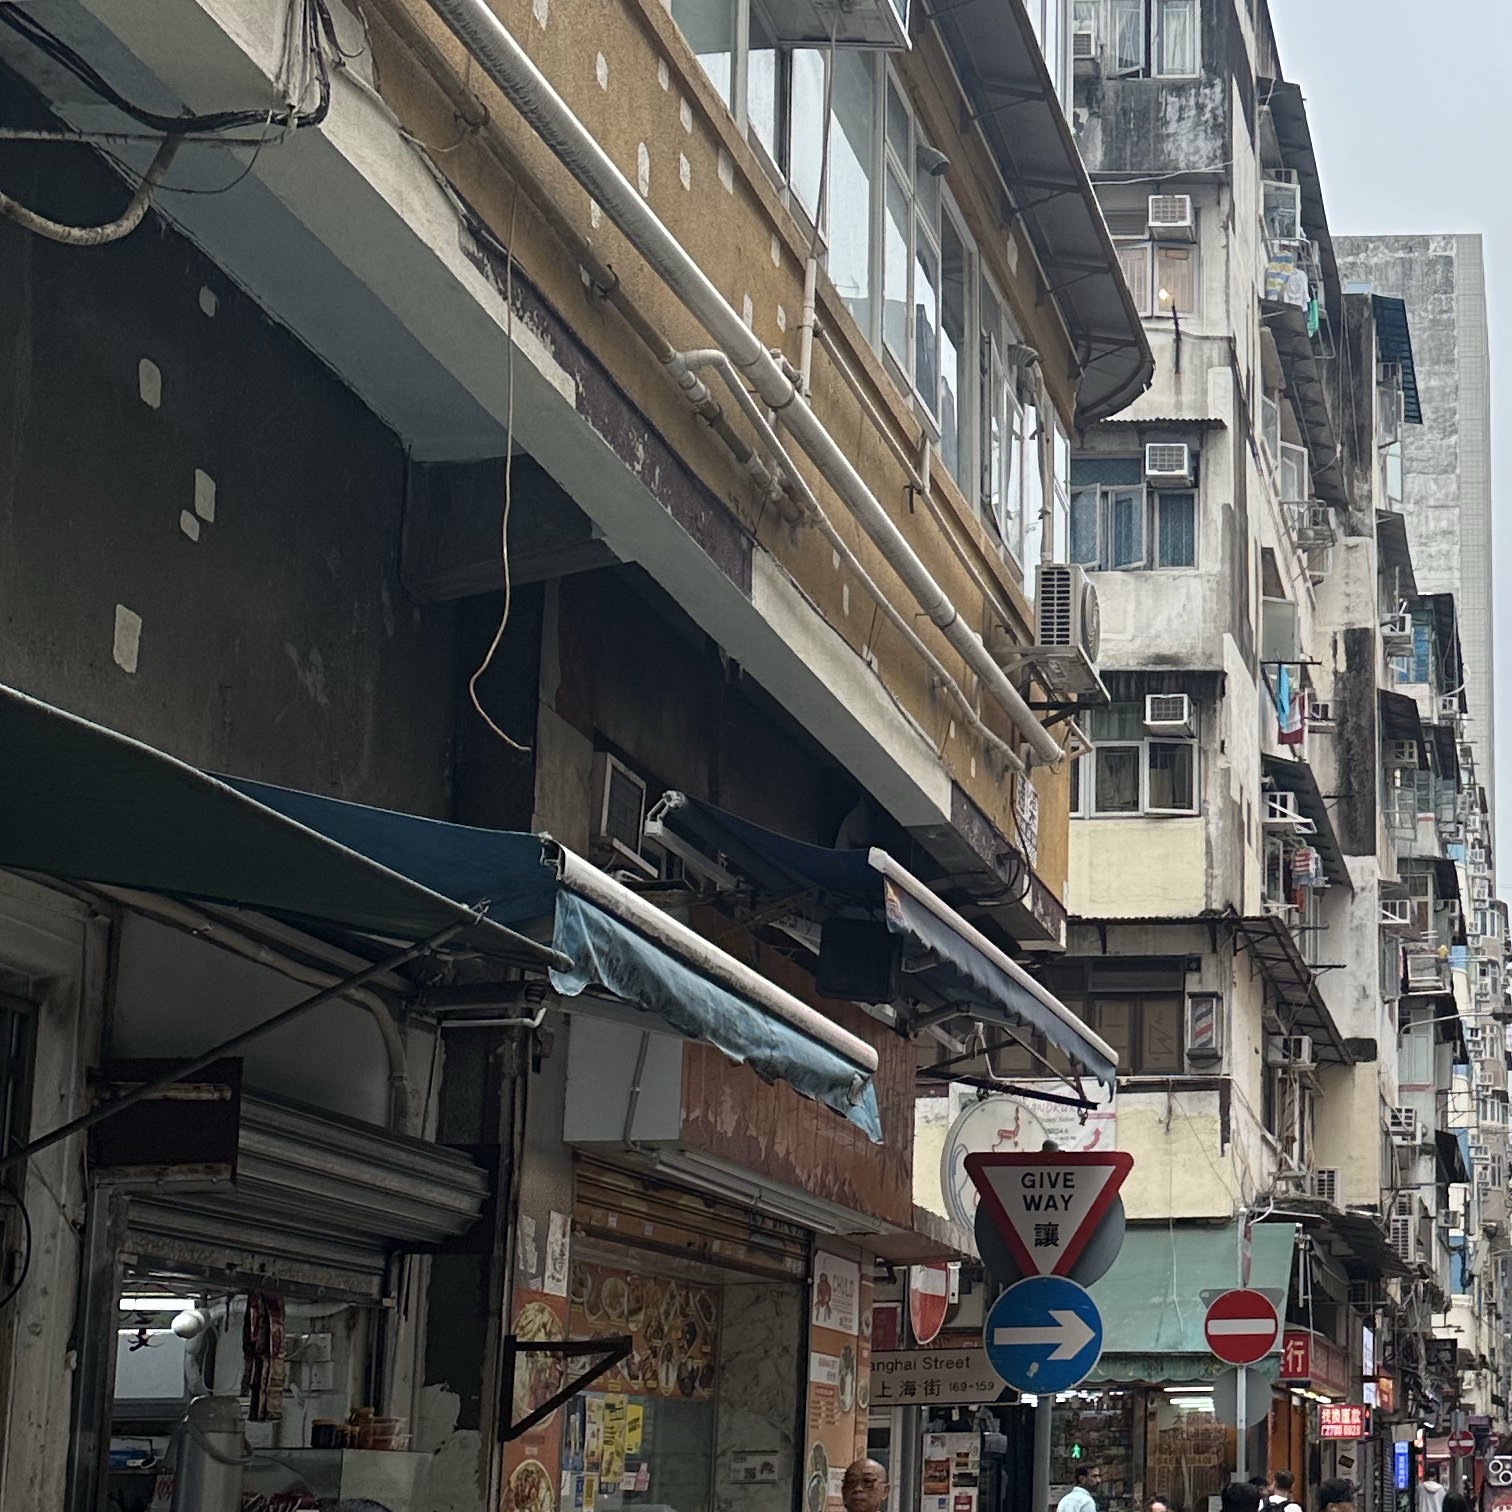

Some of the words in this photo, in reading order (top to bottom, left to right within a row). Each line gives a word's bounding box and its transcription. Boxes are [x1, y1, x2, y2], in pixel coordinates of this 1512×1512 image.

[1021, 1171, 1075, 1189] GIVE
[1022, 1194, 1074, 1211] WAY
[1034, 1222, 1060, 1248] 讓
[871, 1358, 917, 1374] anghai
[922, 1356, 971, 1370] Street
[1284, 1339, 1305, 1373] 行
[875, 1379, 941, 1398] 上海街
[949, 1381, 995, 1392] 169-159
